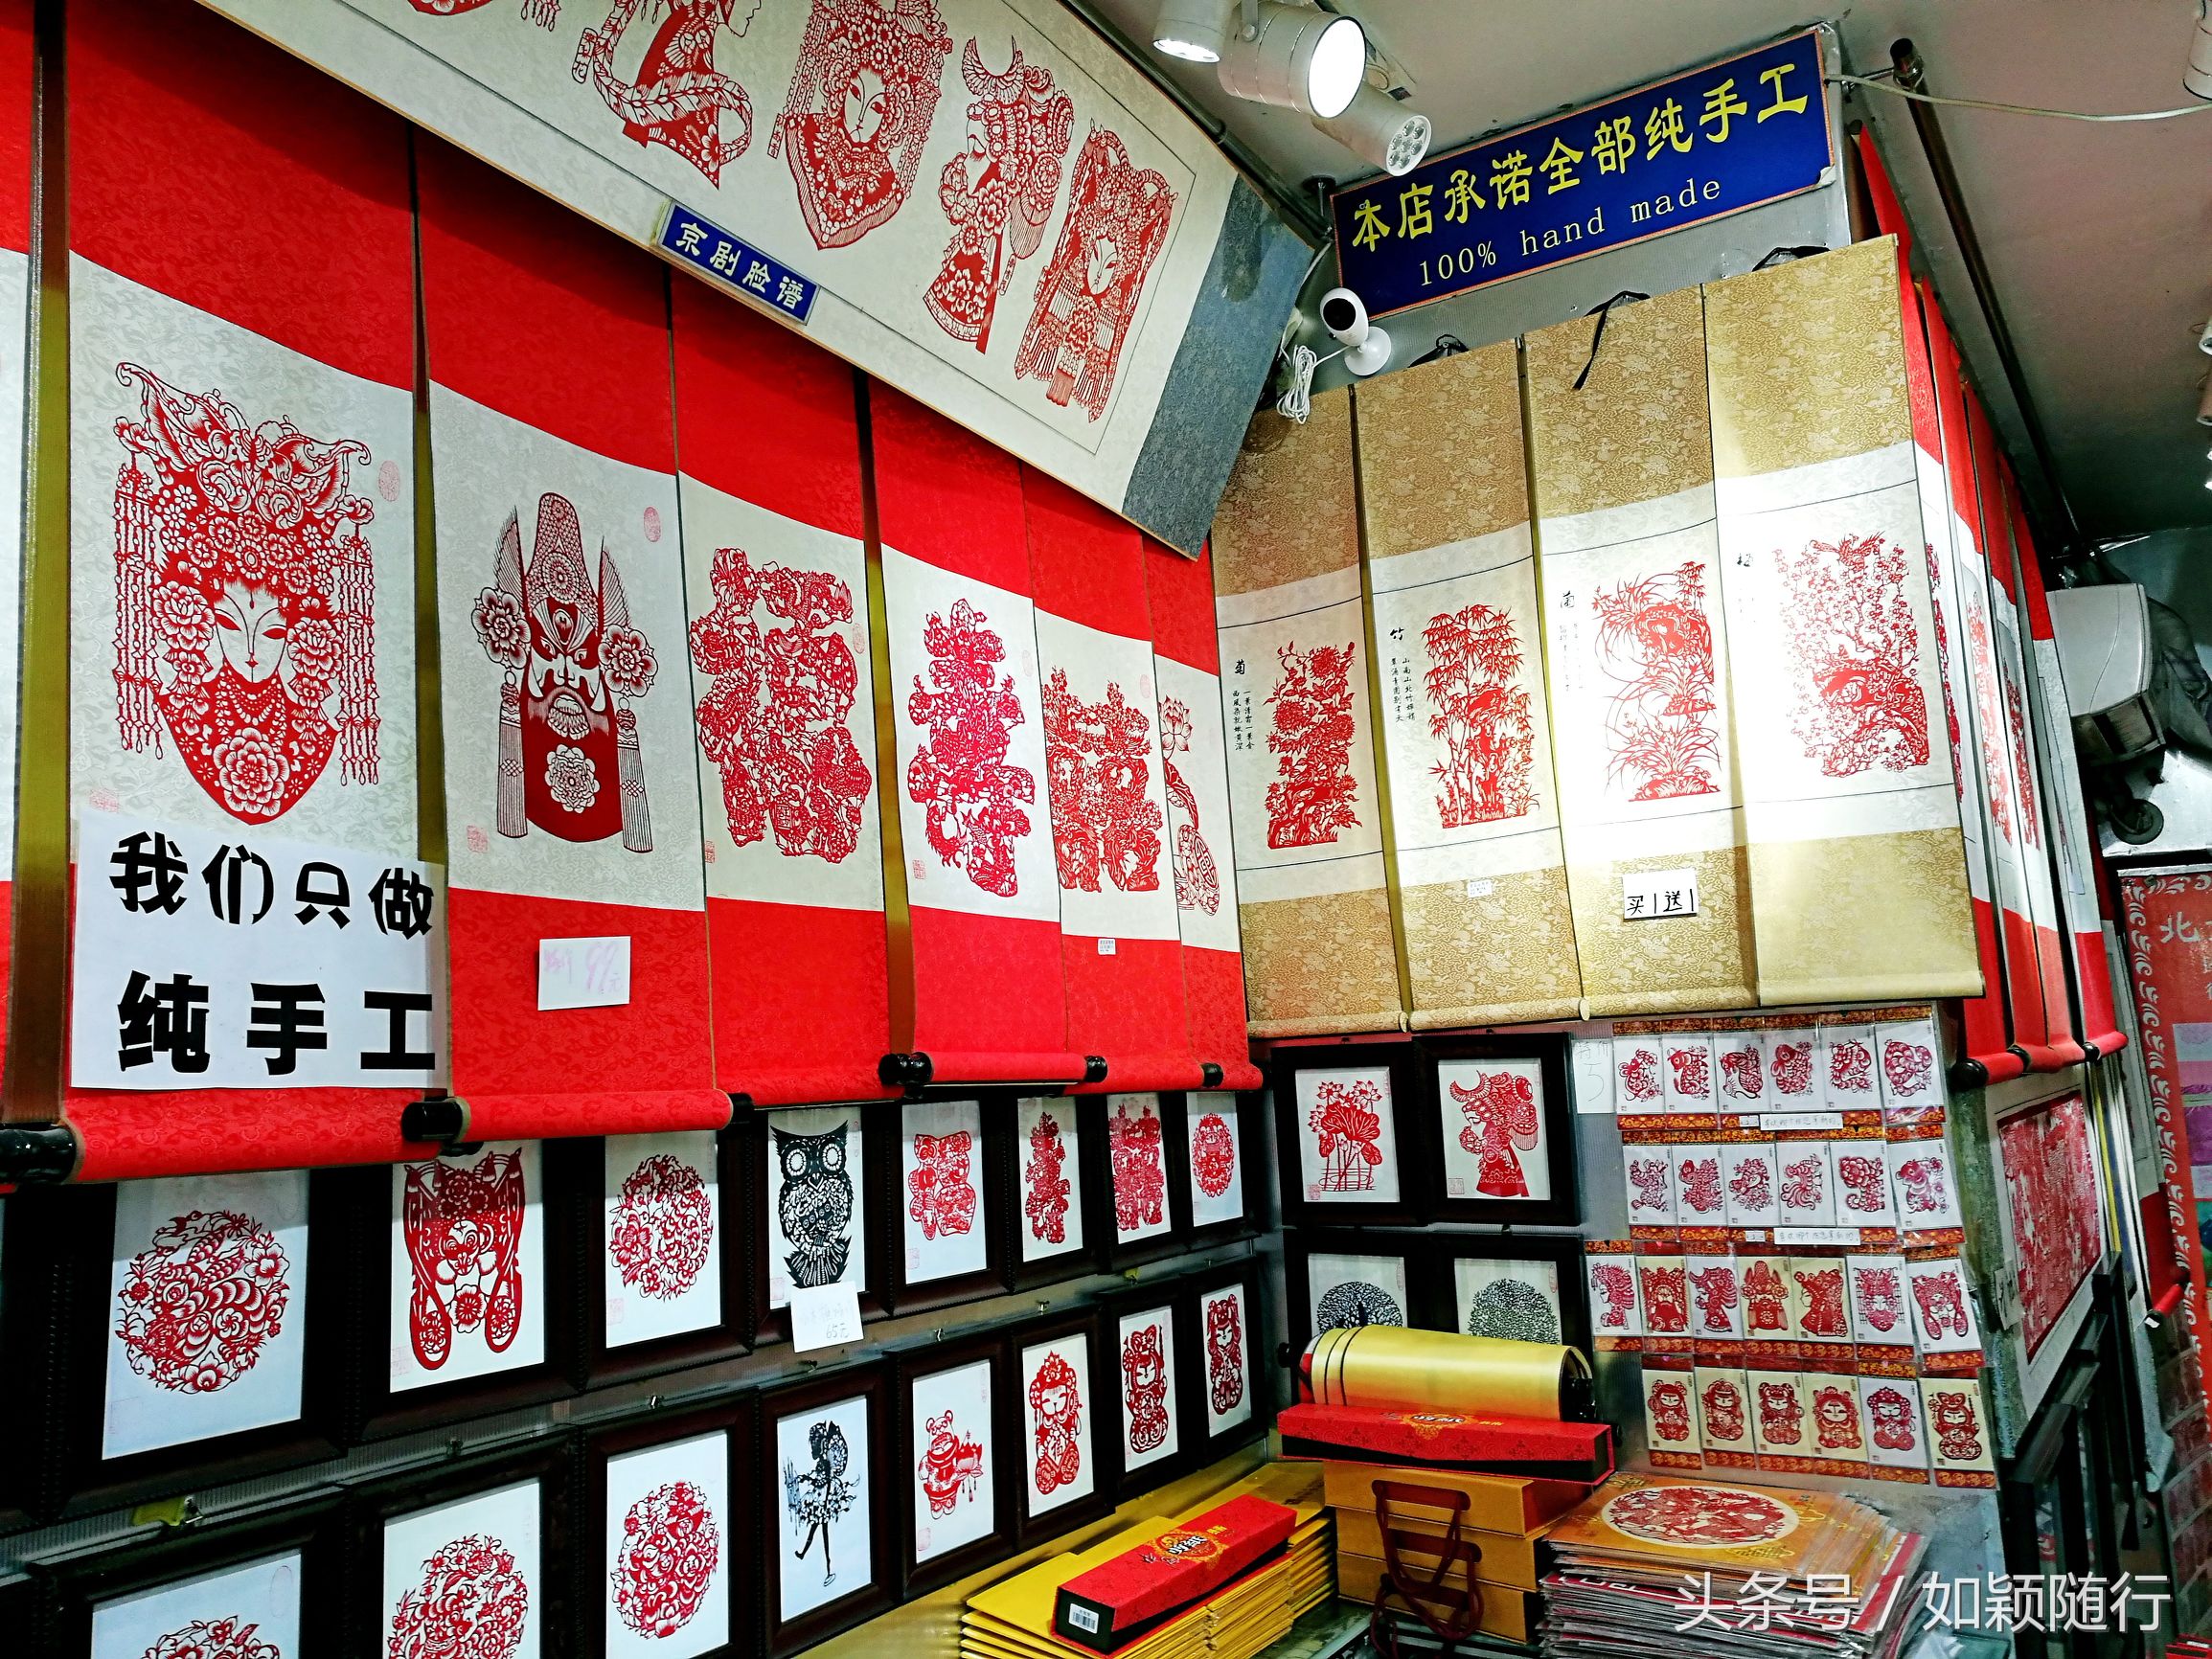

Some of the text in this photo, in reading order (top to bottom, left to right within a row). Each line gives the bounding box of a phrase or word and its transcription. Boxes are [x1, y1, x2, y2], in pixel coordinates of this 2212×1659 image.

[1352, 63, 1809, 252] 本店承诺全部纯手工
[675, 222, 804, 309] 京剧脸谱
[1420, 177, 1722, 285] 100% hand made
[109, 831, 434, 940] 我们只做
[117, 969, 436, 1075] 纯手工
